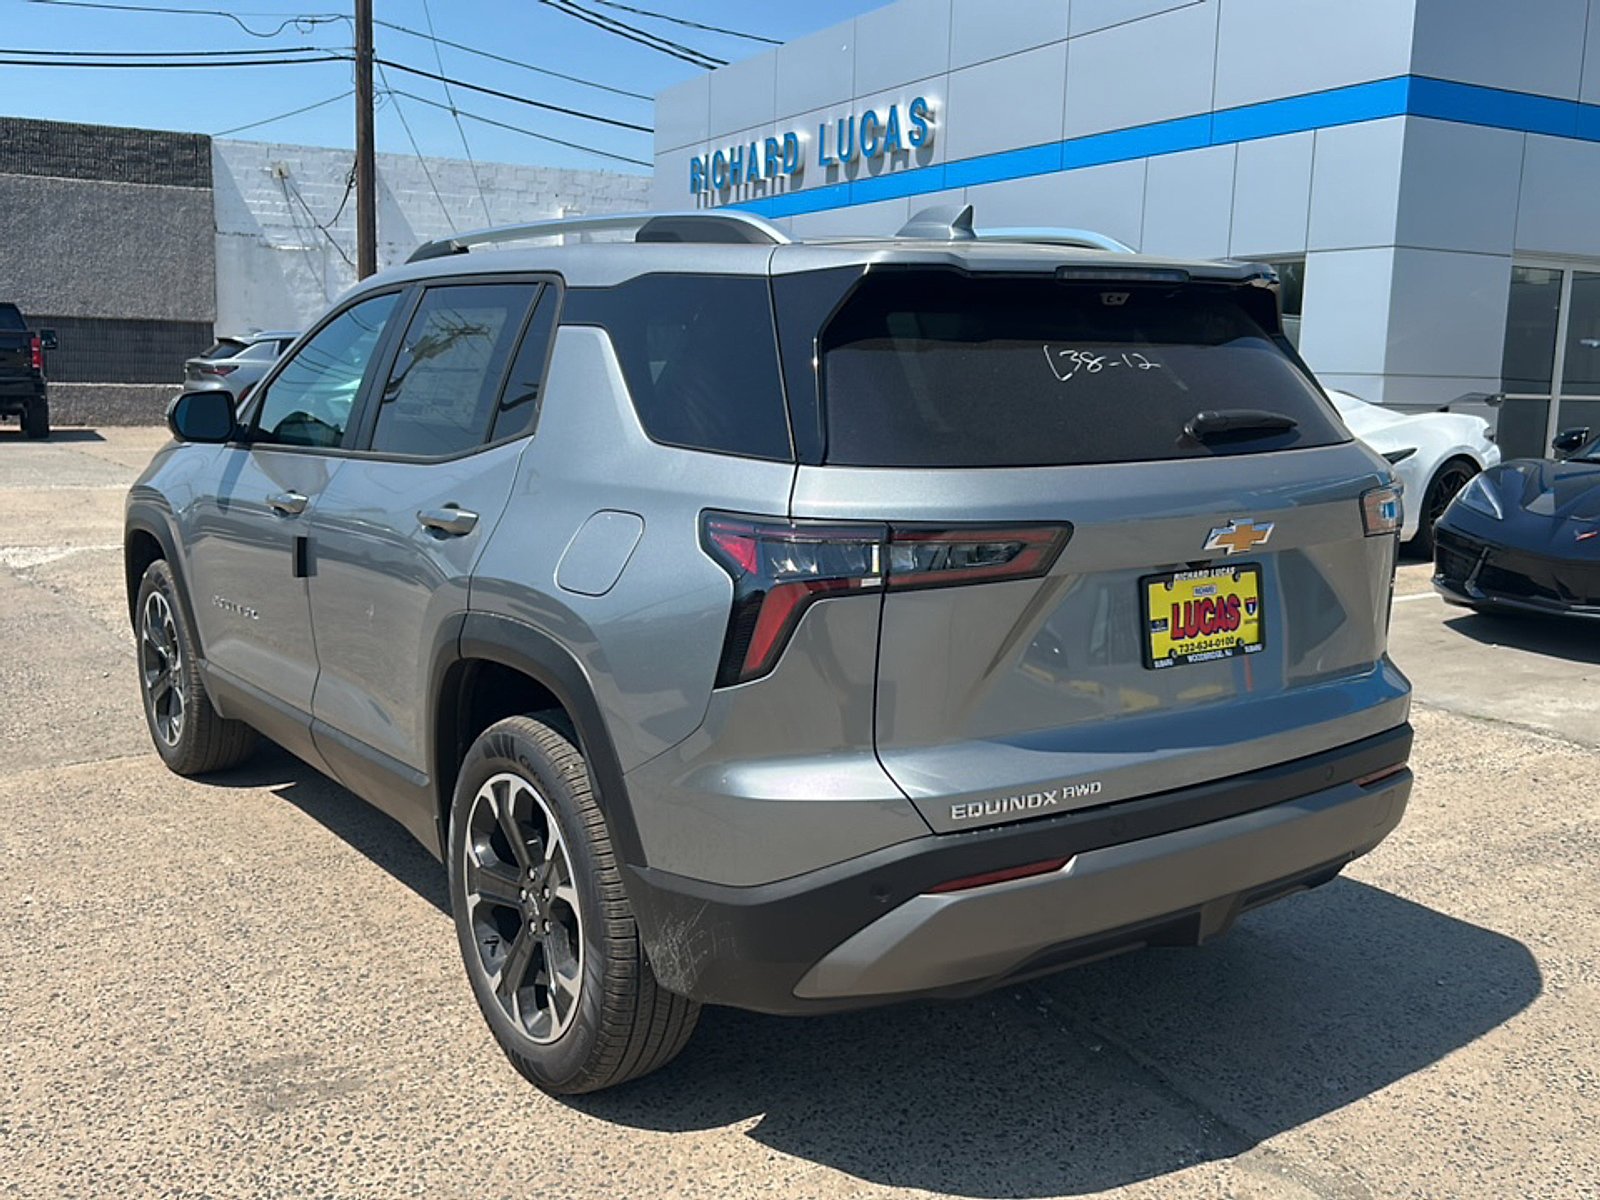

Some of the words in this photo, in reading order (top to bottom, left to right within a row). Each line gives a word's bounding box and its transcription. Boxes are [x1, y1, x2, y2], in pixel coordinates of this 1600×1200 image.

[690, 132, 800, 194] RICHARD
[818, 96, 935, 168] LUCAS
[1171, 593, 1241, 641] LUCAS
[1179, 636, 1235, 653] 732-634-0100
[951, 789, 1058, 820] EQUINOX
[1062, 781, 1102, 800] AWD
